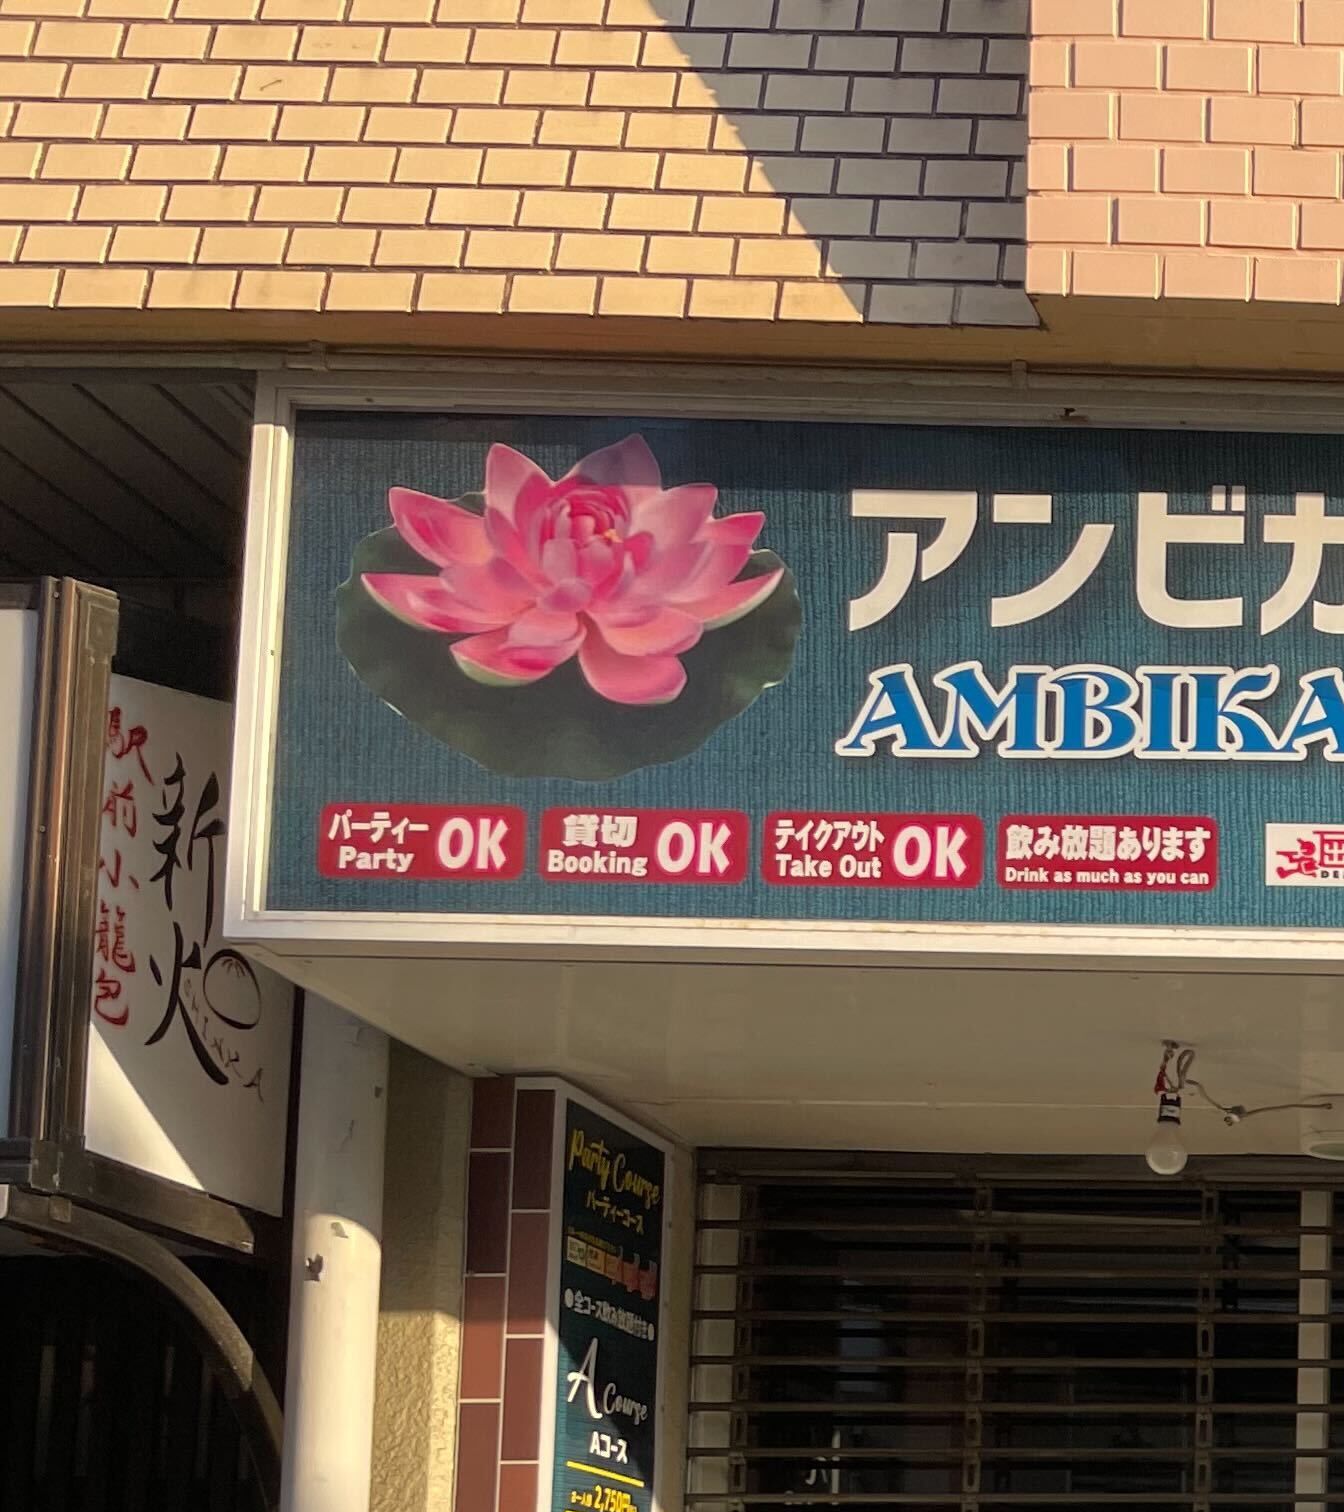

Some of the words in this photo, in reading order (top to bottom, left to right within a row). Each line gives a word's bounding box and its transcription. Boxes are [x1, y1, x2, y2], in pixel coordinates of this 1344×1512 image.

[328, 809, 429, 845] パーティー
[439, 817, 508, 870] OK
[562, 814, 638, 848] 貸切
[656, 821, 732, 874] OK
[775, 819, 885, 852] テイクアウト
[893, 825, 968, 878] OK
[1005, 824, 1212, 863] 飲み放題あります
[339, 845, 414, 872] Party
[548, 850, 648, 877] Booking
[775, 853, 832, 878] Take
[839, 854, 881, 879] Out
[1005, 866, 1049, 883] Drink
[1053, 869, 1073, 883] as
[1077, 868, 1120, 884] much
[1124, 870, 1143, 884] as
[1147, 870, 1177, 886] you
[1181, 870, 1210, 885] can
